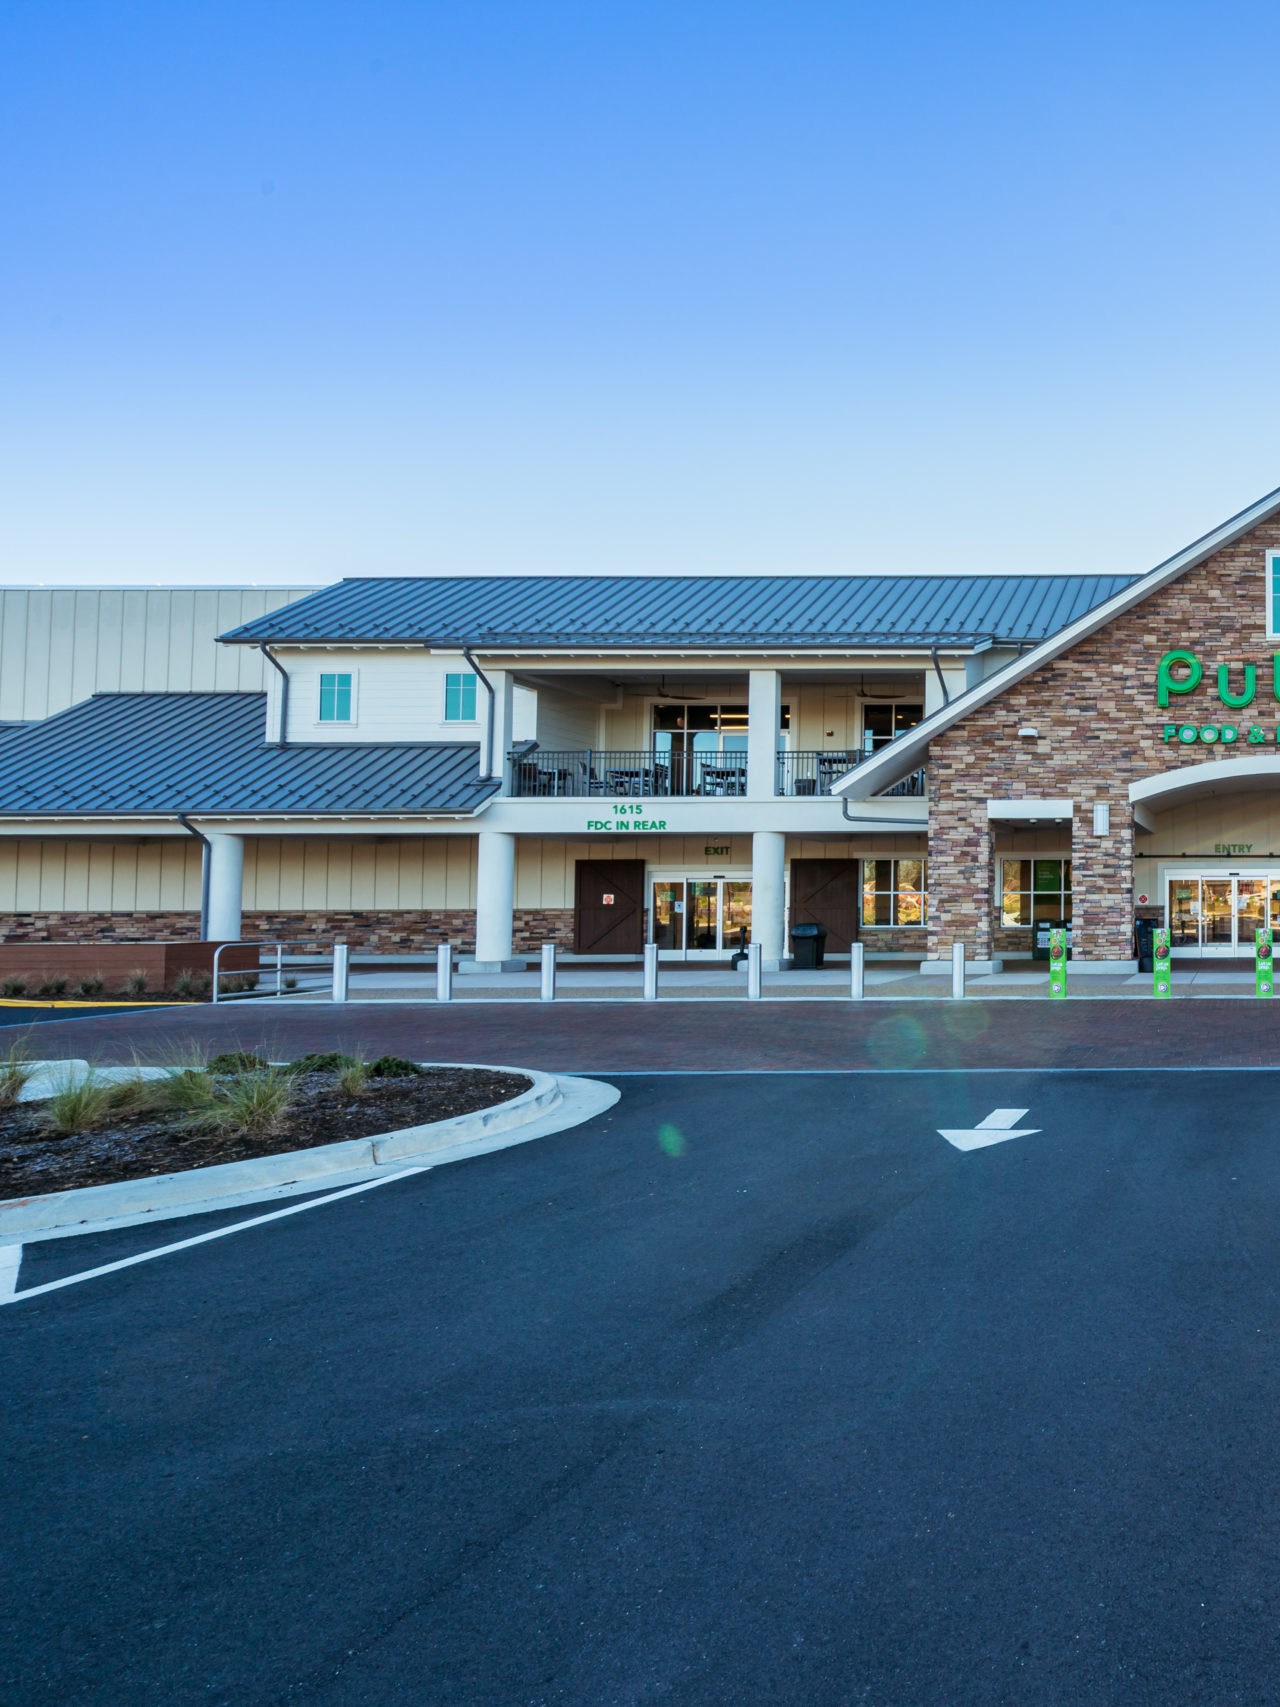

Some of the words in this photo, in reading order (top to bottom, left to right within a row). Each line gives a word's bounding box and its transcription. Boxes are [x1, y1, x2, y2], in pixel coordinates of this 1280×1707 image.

[1163, 724, 1238, 744] FOOD
[1248, 724, 1266, 744] &
[612, 804, 643, 815] 1615
[587, 820, 613, 831] FDC
[616, 820, 630, 831] IN
[633, 820, 667, 831] REAR
[704, 846, 731, 856] EXIT
[1214, 843, 1253, 853] ENTRY
